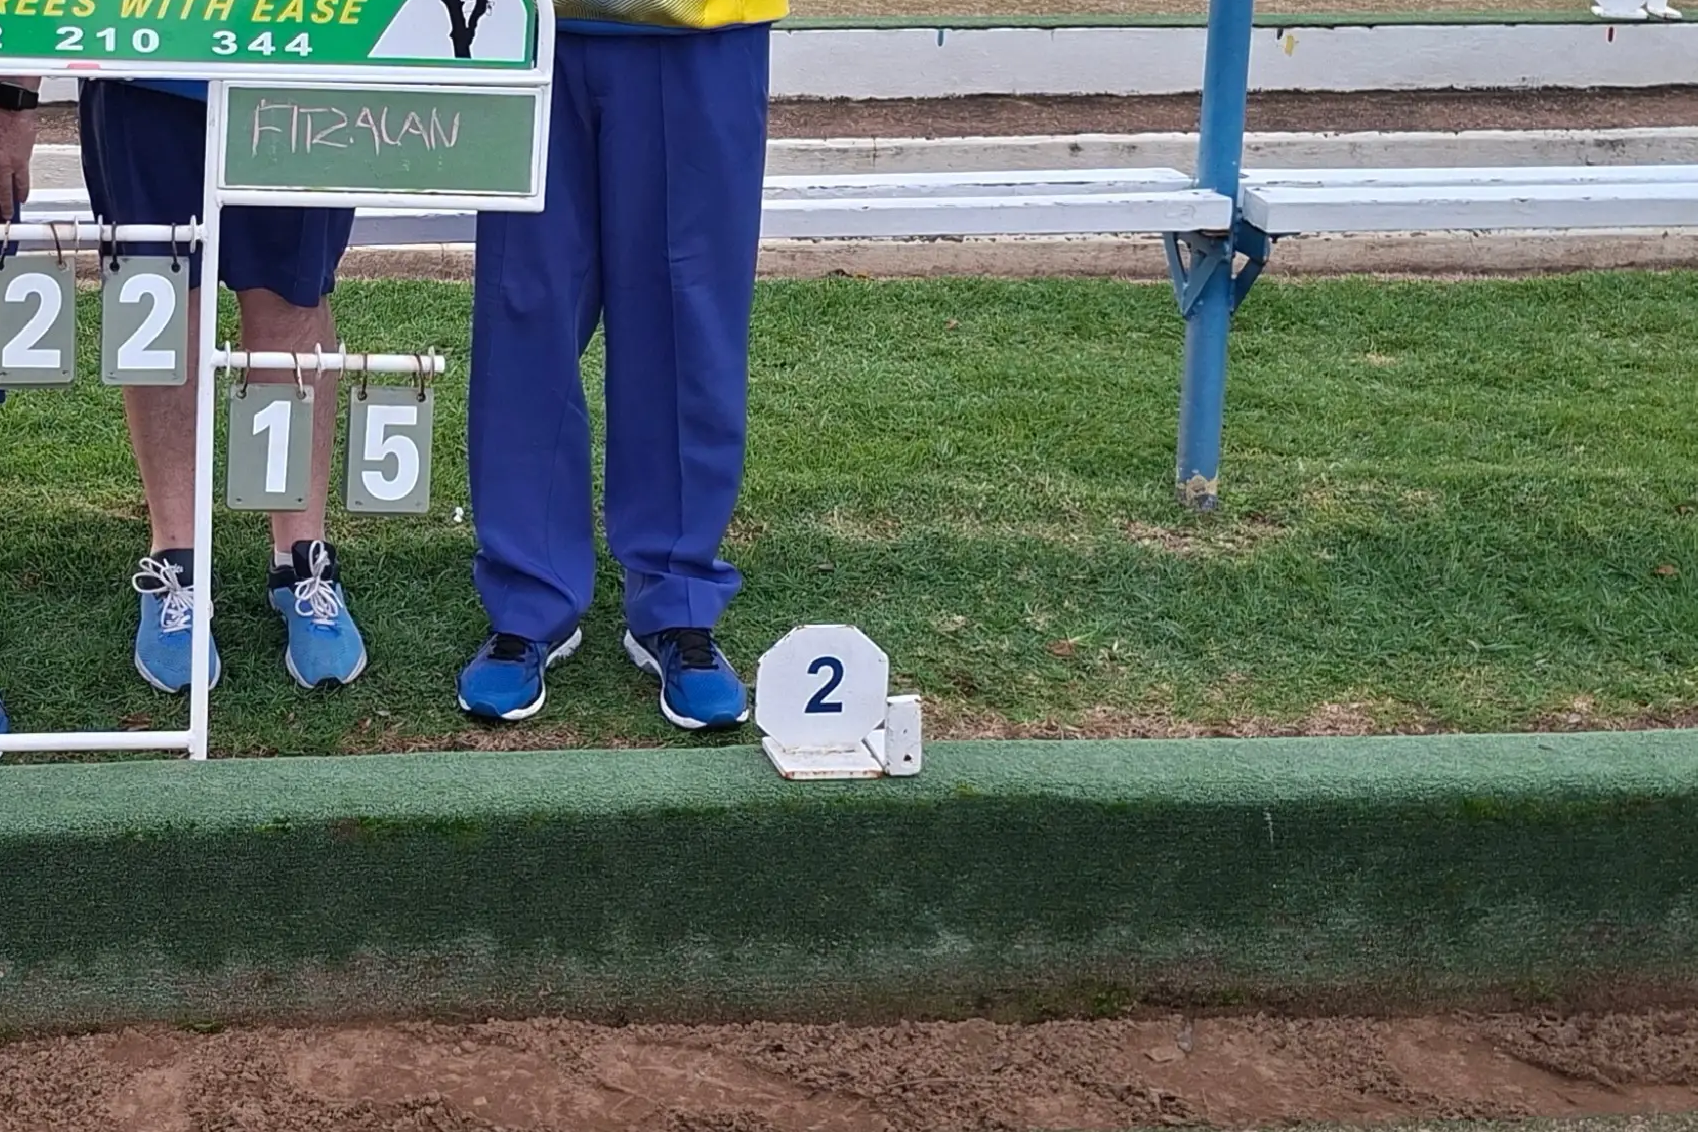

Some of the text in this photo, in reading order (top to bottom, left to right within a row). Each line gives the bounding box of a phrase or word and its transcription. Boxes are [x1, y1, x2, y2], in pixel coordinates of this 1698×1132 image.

[54, 25, 160, 53] 210
[211, 30, 313, 57] 344
[806, 655, 844, 714] 2
